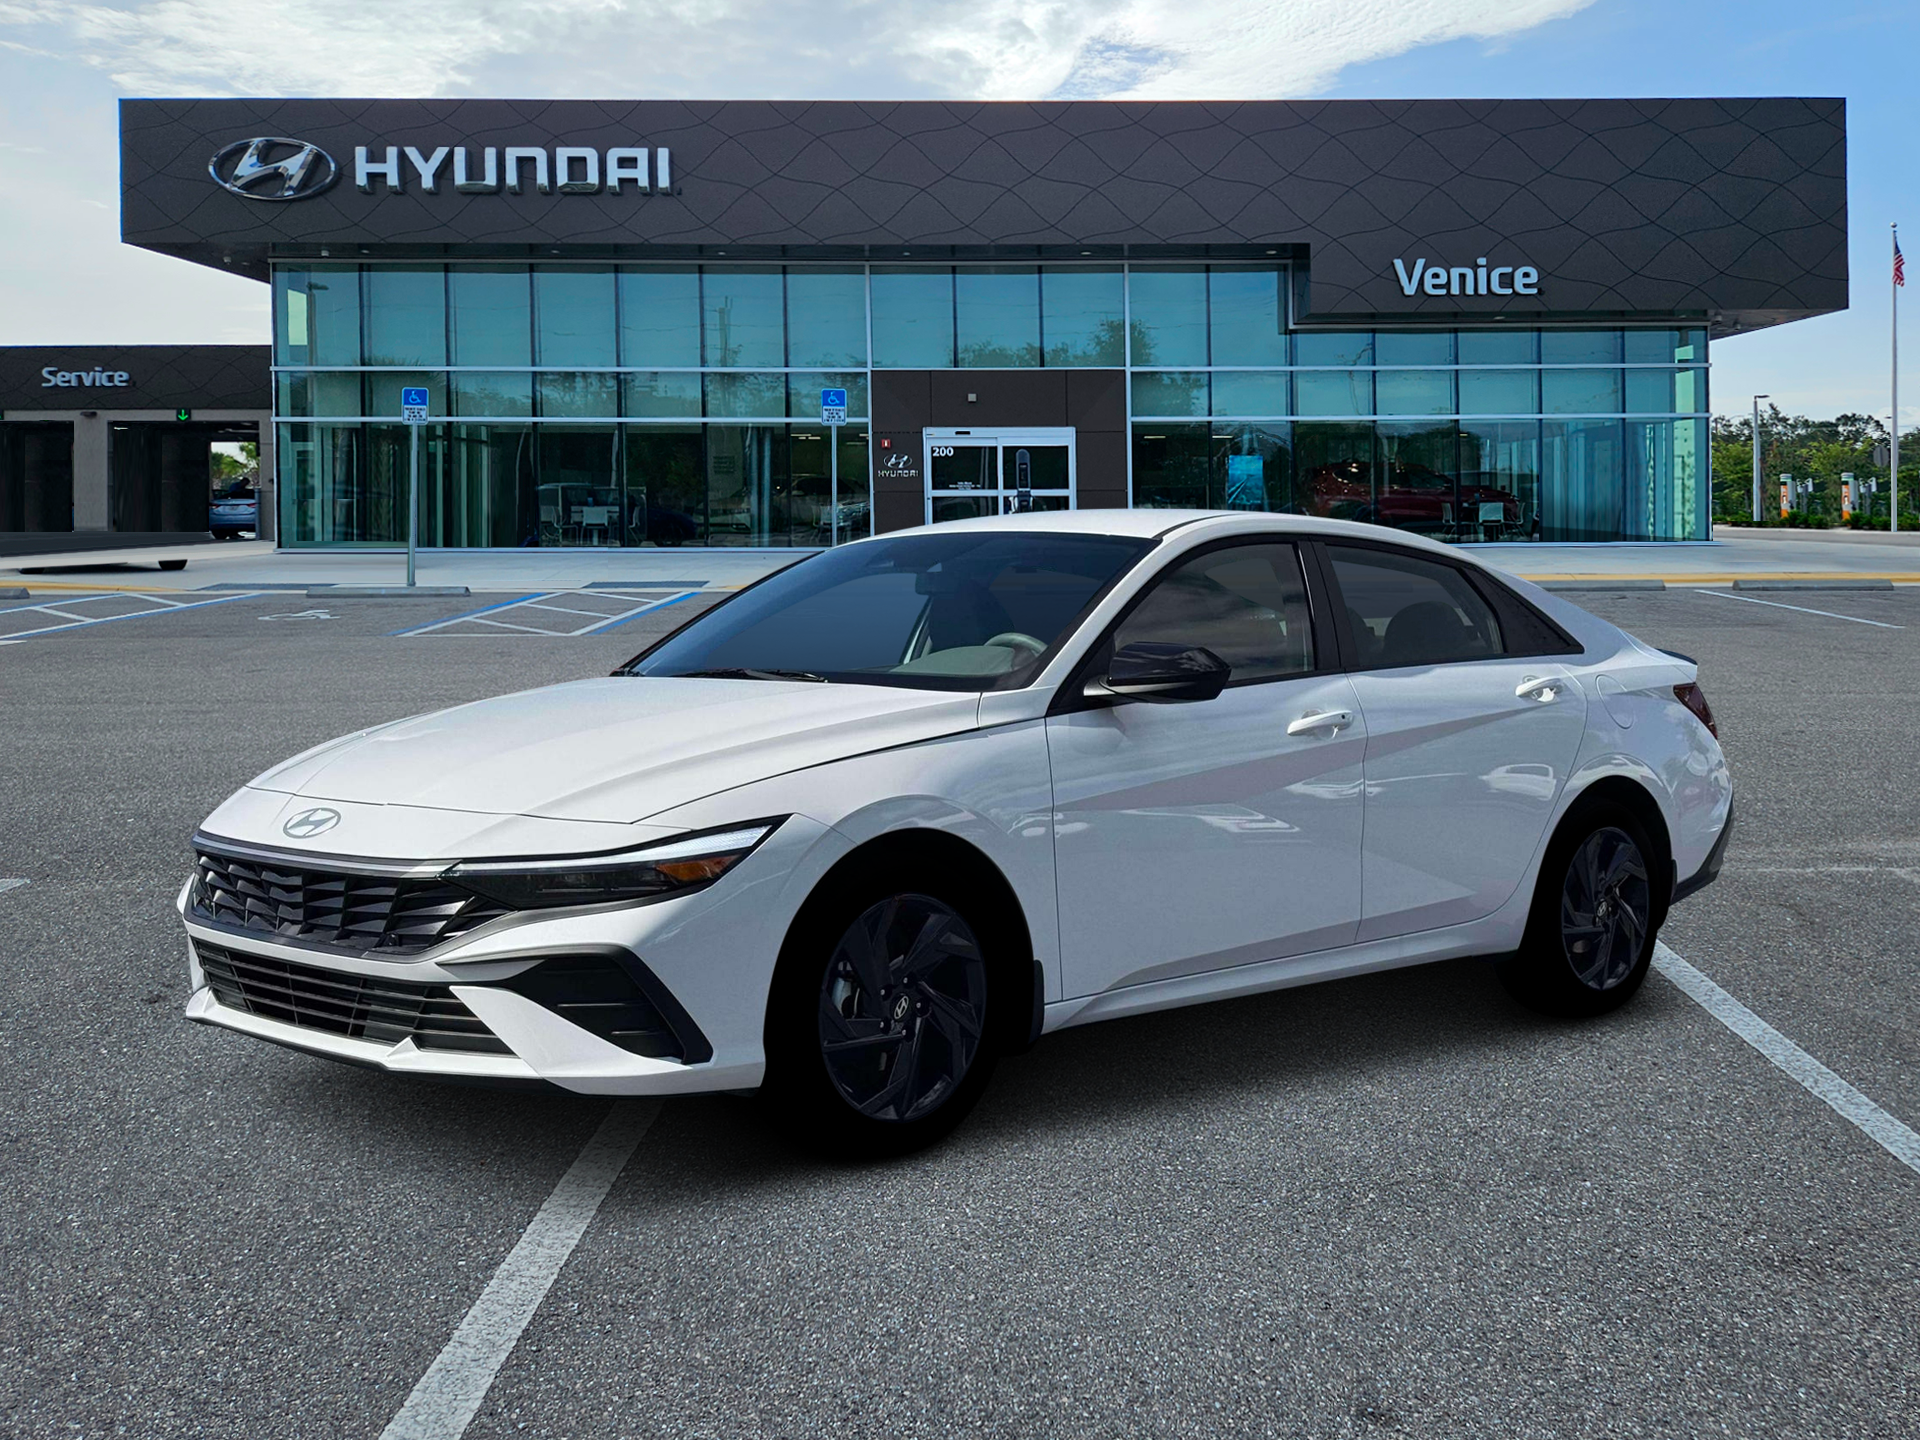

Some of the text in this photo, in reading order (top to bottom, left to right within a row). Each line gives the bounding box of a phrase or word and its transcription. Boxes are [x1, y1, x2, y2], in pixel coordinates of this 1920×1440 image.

[354, 146, 671, 194] HYUNDAI
[1393, 257, 1539, 296] Venice
[41, 366, 130, 387] Service
[932, 447, 954, 457] 200
